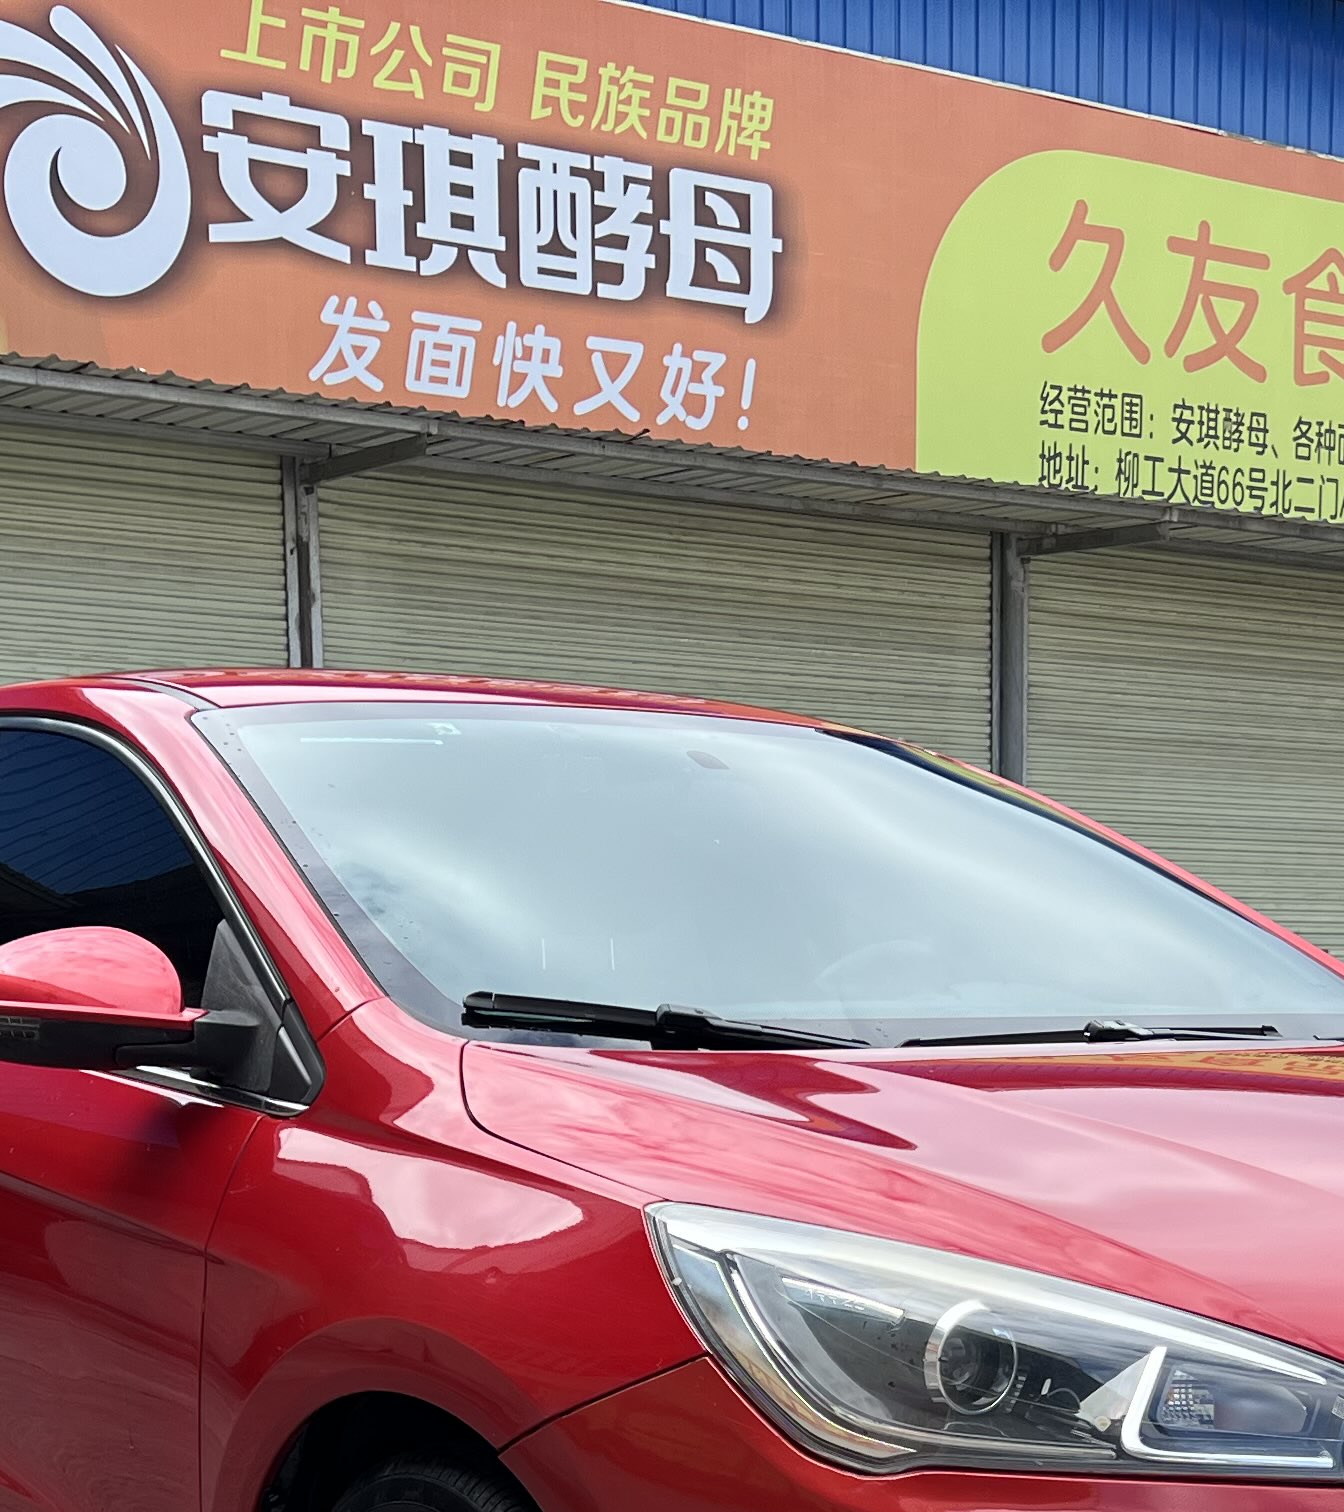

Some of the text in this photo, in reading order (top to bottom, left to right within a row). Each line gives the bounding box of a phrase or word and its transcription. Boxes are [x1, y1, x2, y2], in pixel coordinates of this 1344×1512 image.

[220, 0, 775, 161] 上市公司 民族品牌
[201, 89, 783, 324] 安琪酵母
[309, 295, 758, 431] 发面快又好!
